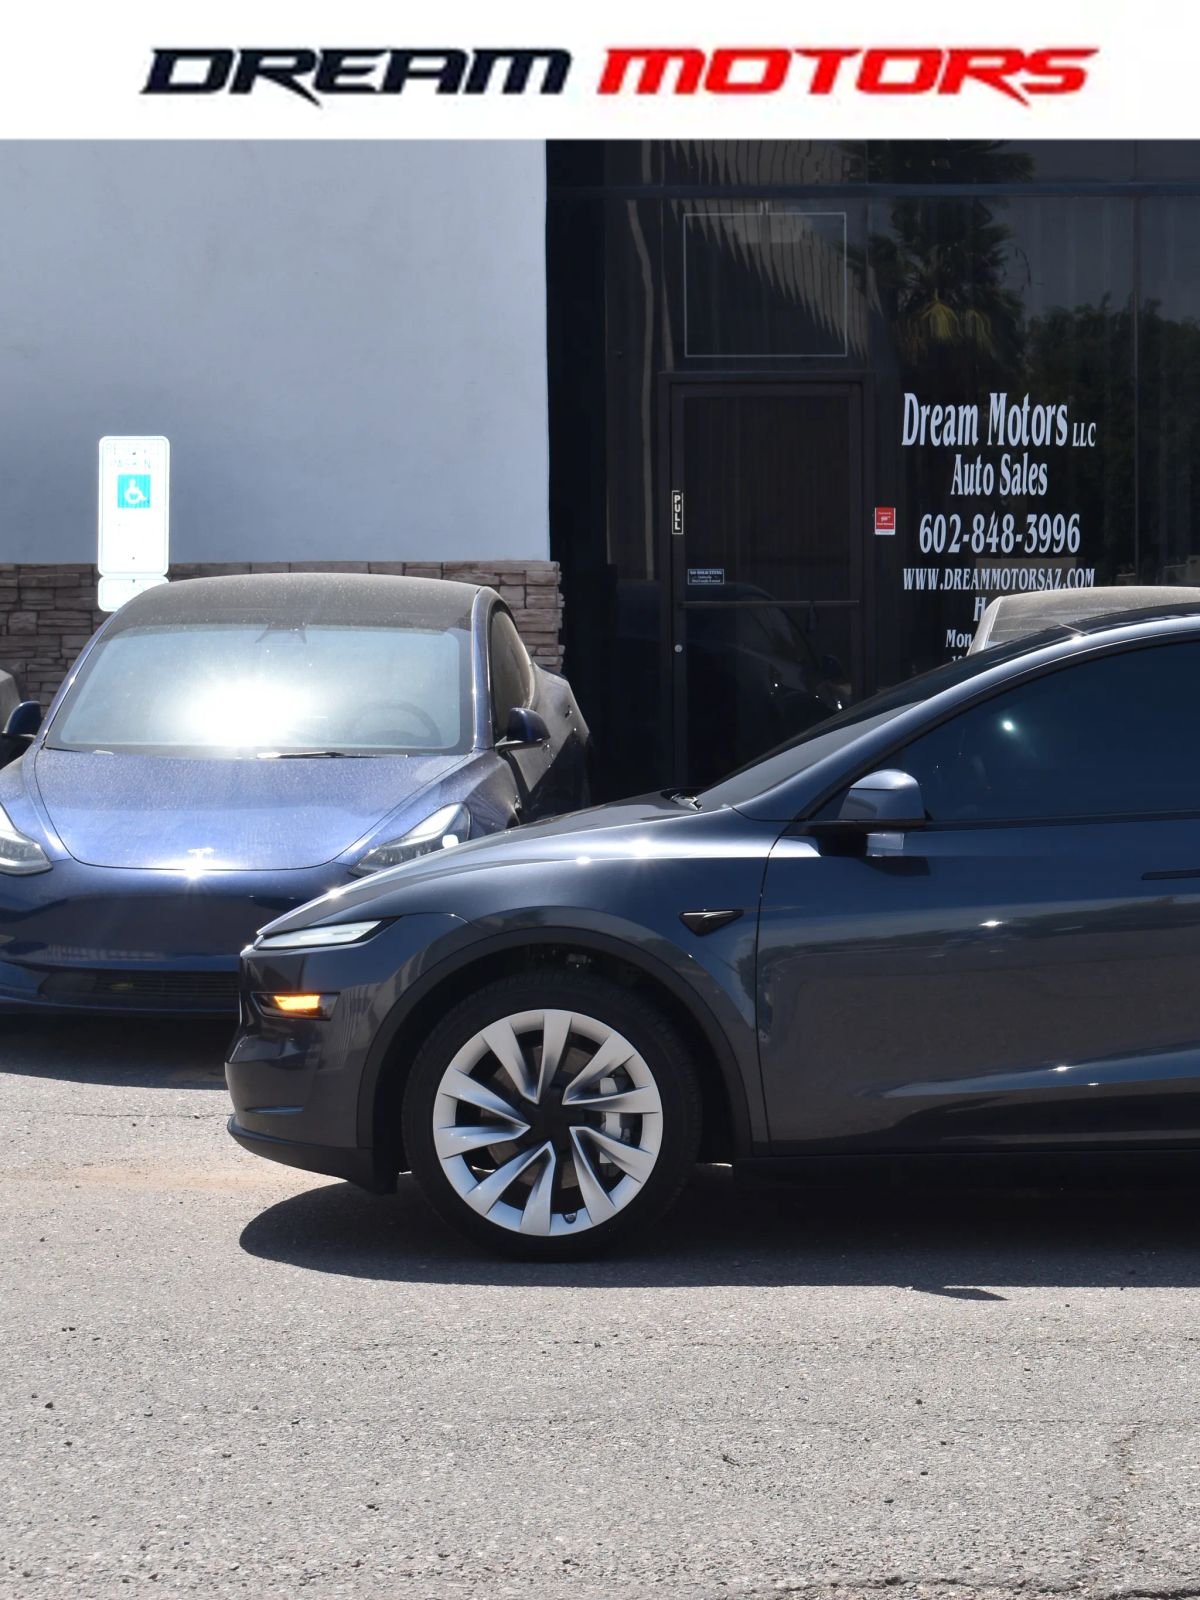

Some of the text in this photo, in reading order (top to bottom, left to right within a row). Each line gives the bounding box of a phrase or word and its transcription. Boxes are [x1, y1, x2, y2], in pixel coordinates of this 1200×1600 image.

[901, 392, 1097, 447] Dream Motors LLC
[950, 452, 1048, 496] Auto Sales
[919, 511, 1081, 554] 602-848-3996
[903, 567, 1096, 591] WWW.DREAMMOTORSAZ.COM
